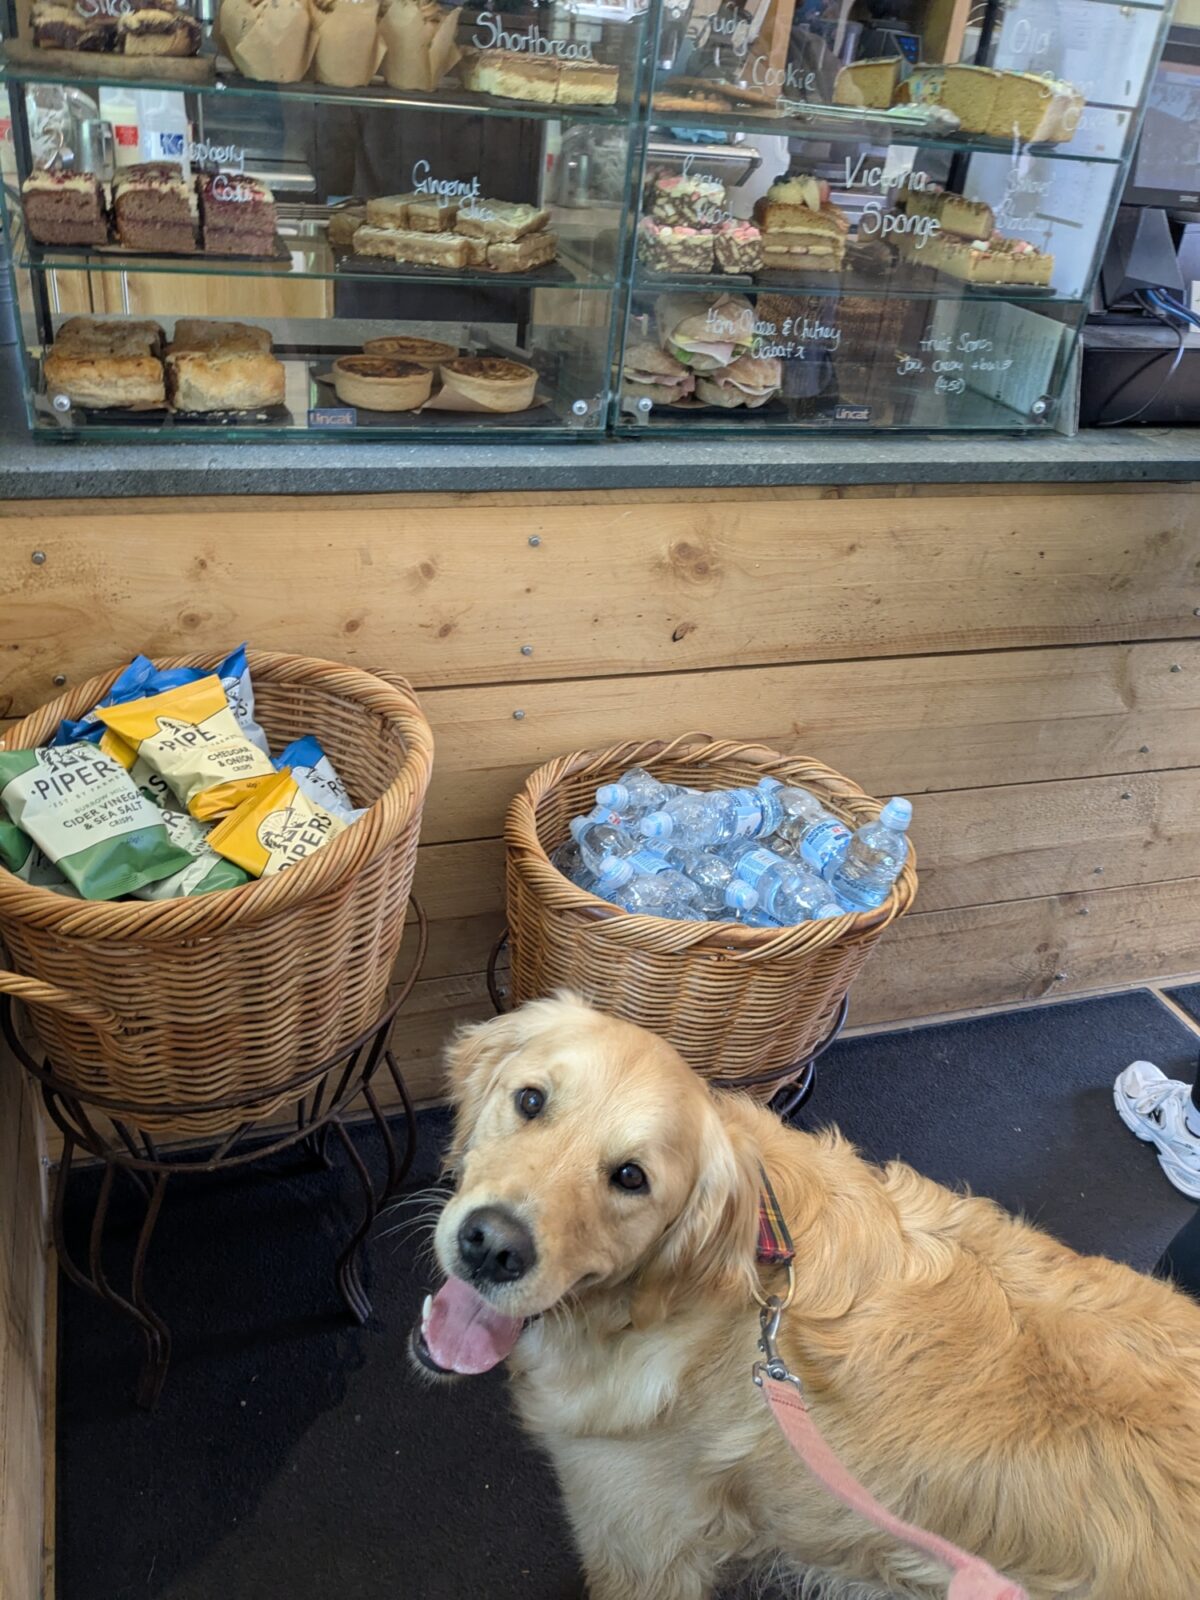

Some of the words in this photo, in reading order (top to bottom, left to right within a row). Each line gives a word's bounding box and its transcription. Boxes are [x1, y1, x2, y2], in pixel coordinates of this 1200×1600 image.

[472, 11, 594, 61] Shortbread
[751, 55, 816, 91] Cookie
[845, 152, 928, 191] Victoria
[862, 202, 941, 249] Sponge
[160, 728, 217, 751] PIPE
[225, 754, 255, 767] ONION
[63, 808, 101, 828] CIDER
[100, 789, 144, 810] VINEGA
[83, 821, 93, 830] &
[93, 811, 118, 825] SEA
[117, 801, 143, 815] SALT
[108, 815, 134, 828] CRISPS
